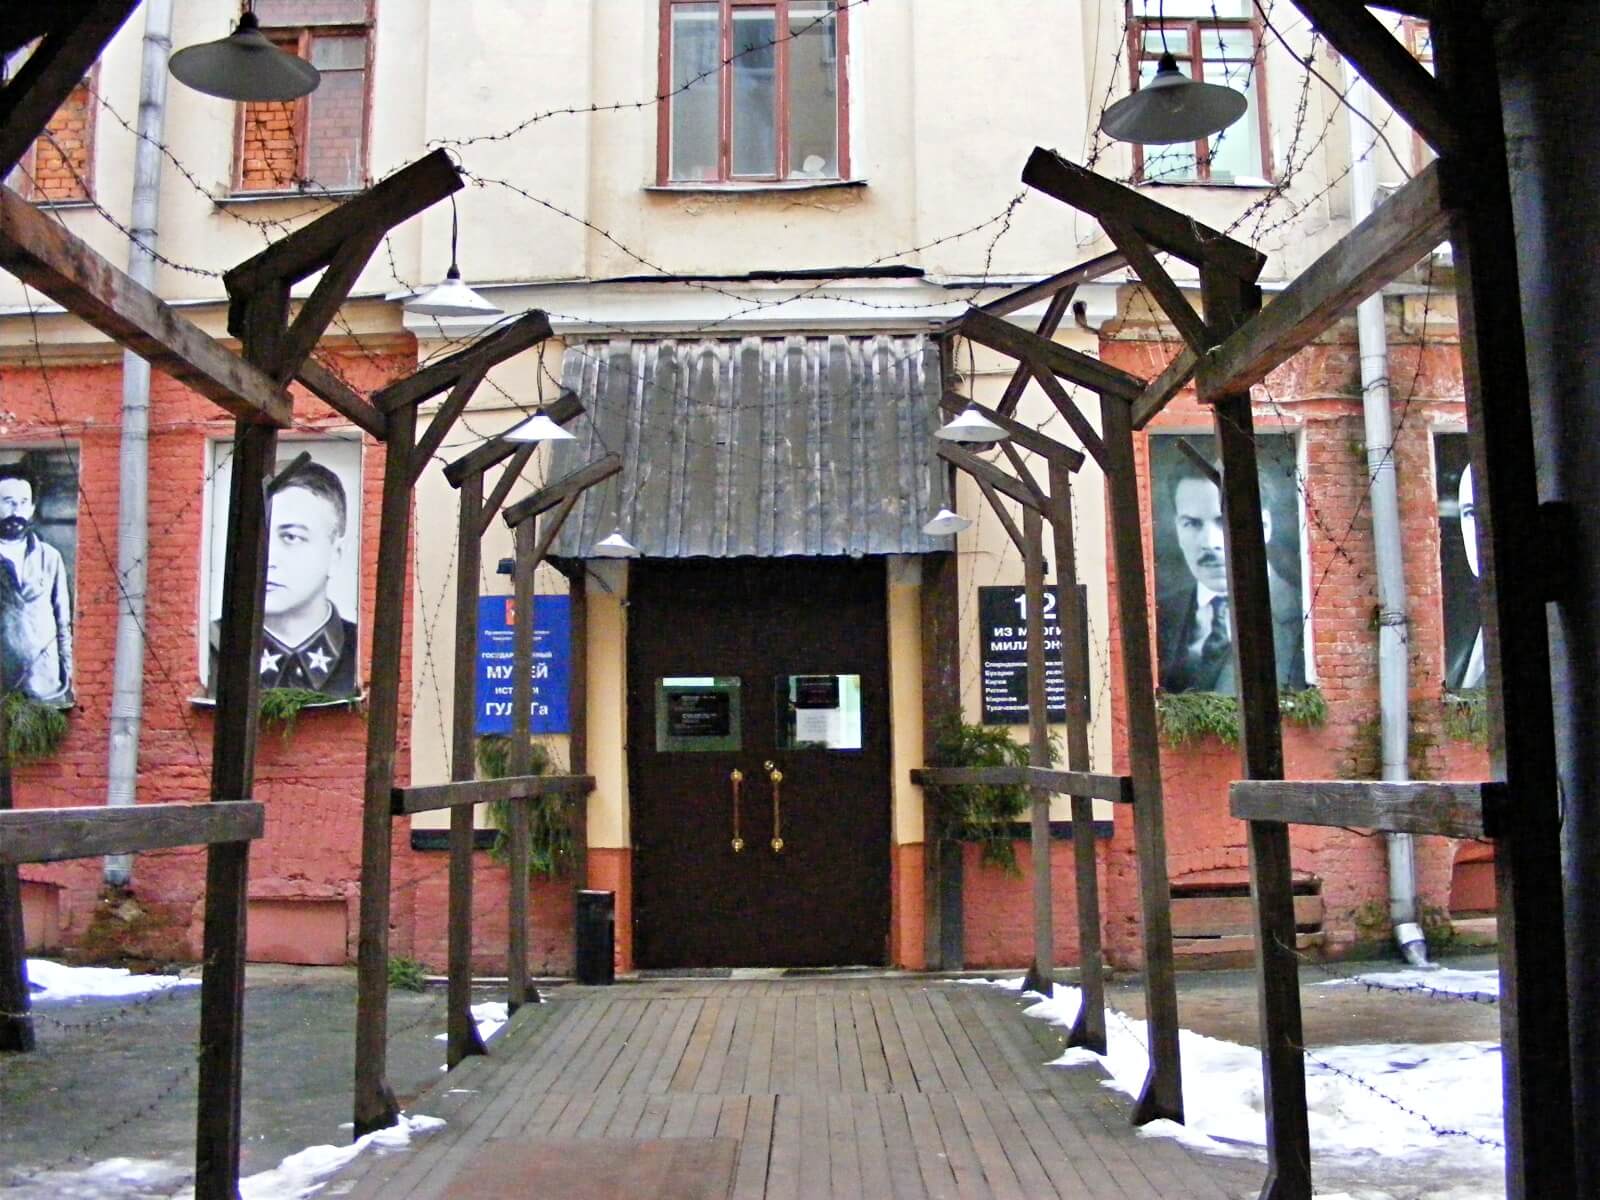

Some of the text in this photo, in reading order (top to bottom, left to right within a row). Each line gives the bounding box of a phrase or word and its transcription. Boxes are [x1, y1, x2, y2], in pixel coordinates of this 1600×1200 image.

[1014, 592, 1057, 620] 12
[990, 640, 1063, 651] миллон
[486, 663, 549, 679] МУЙ
[485, 702, 549, 716] ГУЛГа
